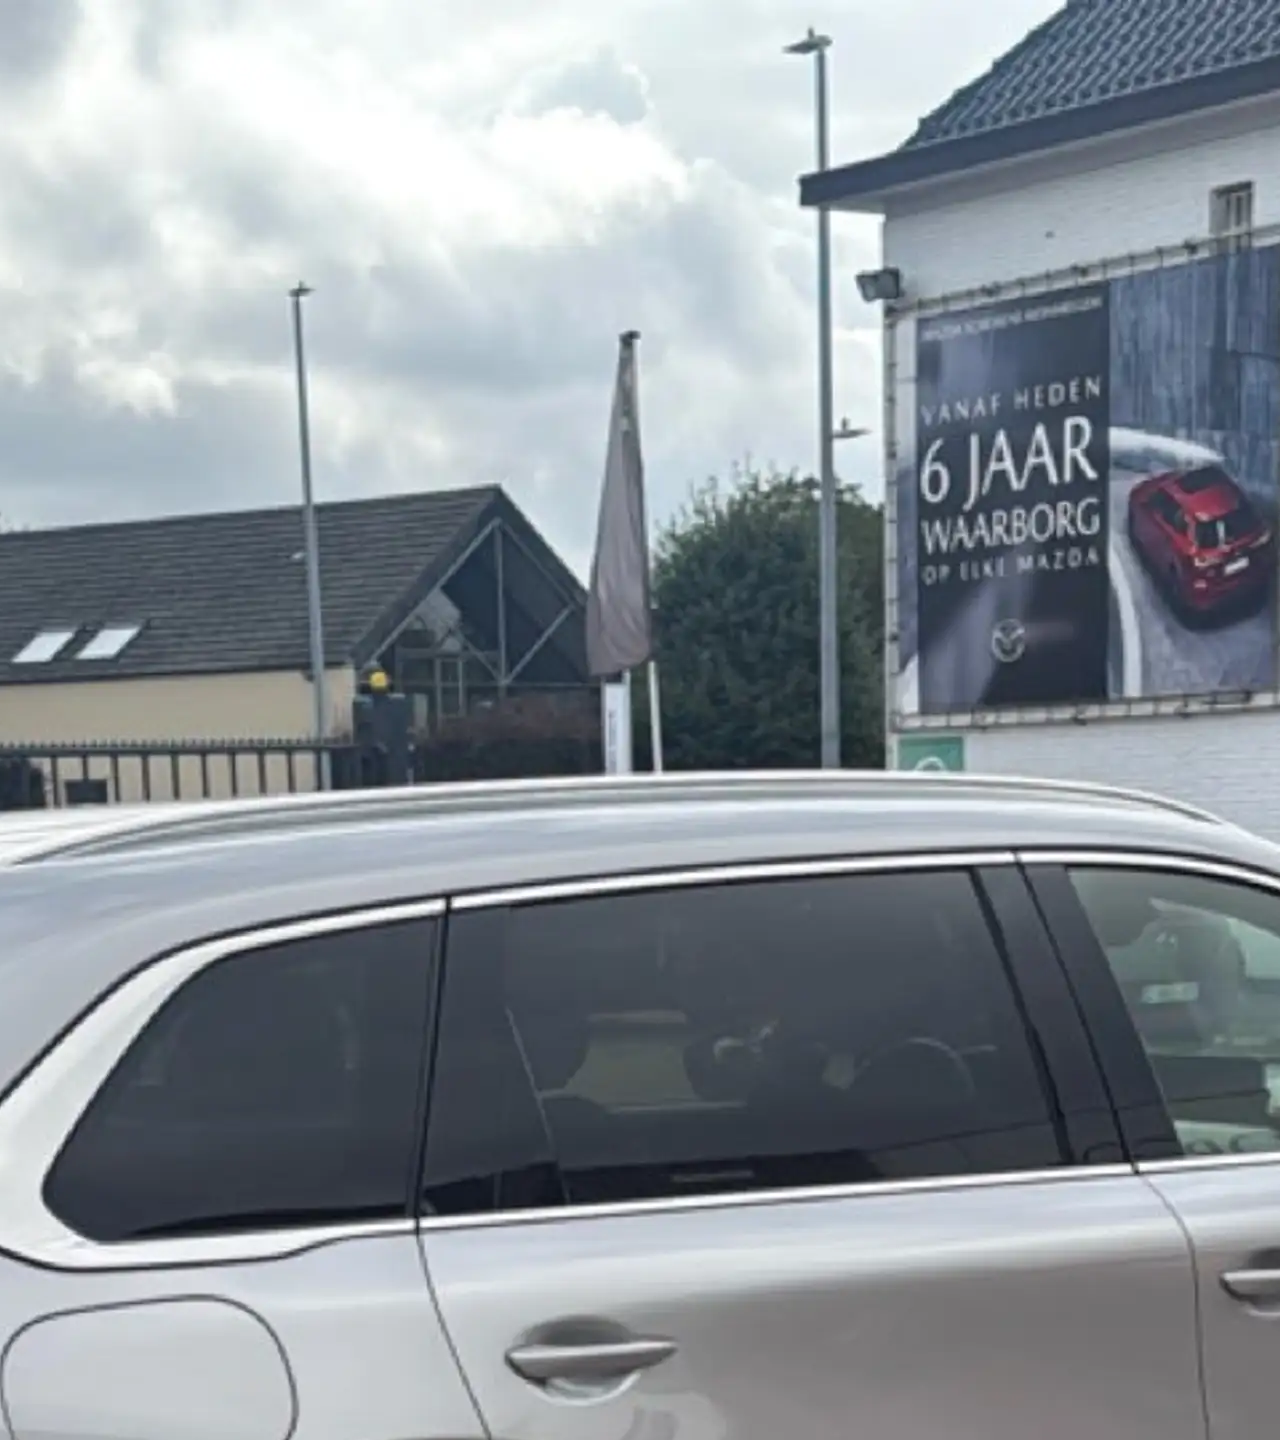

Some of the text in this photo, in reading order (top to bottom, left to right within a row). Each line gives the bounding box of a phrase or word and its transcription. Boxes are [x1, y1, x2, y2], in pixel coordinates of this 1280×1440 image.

[921, 375, 1101, 427] VANAF HEDEN
[921, 415, 1099, 512] 6 JAAR
[921, 497, 1101, 556] WAARBORG
[922, 564, 951, 586] OP
[1017, 546, 1100, 571] MAZDA
